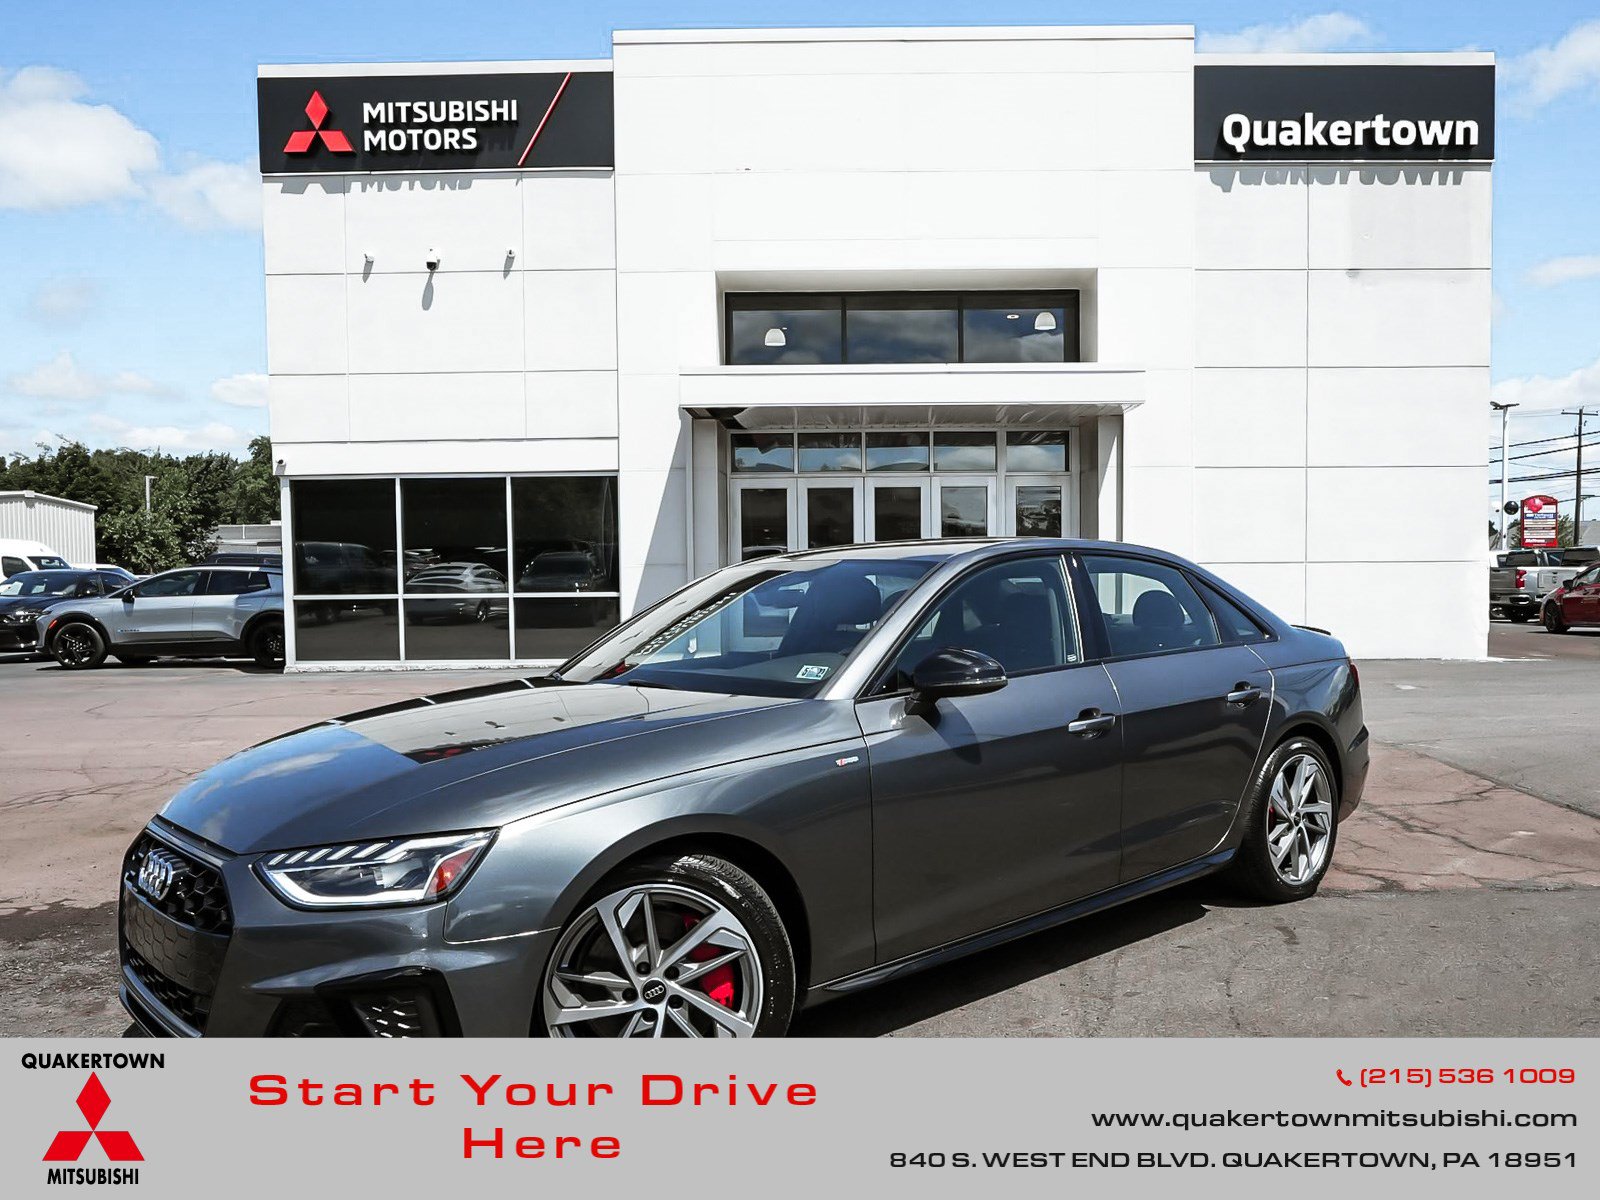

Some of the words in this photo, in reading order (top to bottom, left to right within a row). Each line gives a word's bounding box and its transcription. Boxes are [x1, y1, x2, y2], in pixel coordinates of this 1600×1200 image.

[362, 99, 518, 124] MITSUBISHI
[363, 127, 478, 152] MOTORS
[1222, 112, 1479, 153] Quakertown
